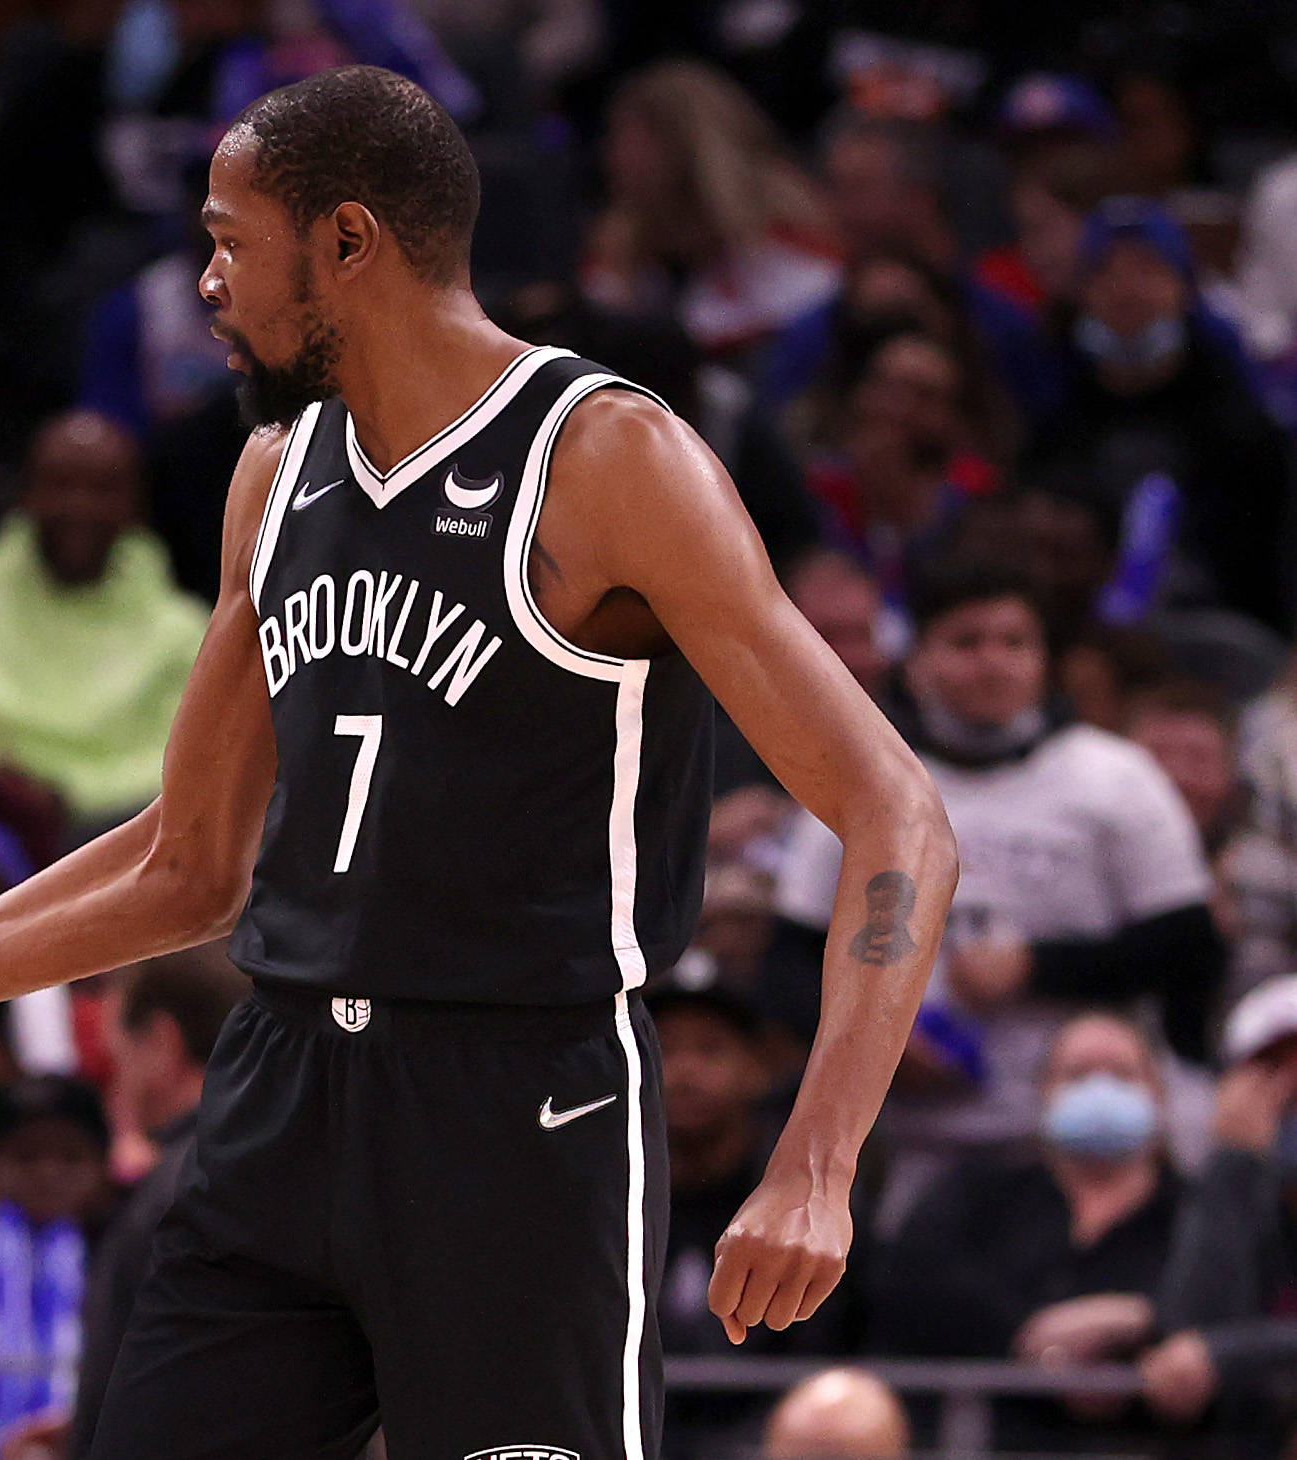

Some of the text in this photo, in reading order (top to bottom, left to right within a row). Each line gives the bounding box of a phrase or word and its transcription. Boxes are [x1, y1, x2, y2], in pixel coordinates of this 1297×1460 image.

[435, 515, 487, 538] Webull
[258, 569, 502, 707] BROOKLYN
[333, 714, 383, 873] 7
